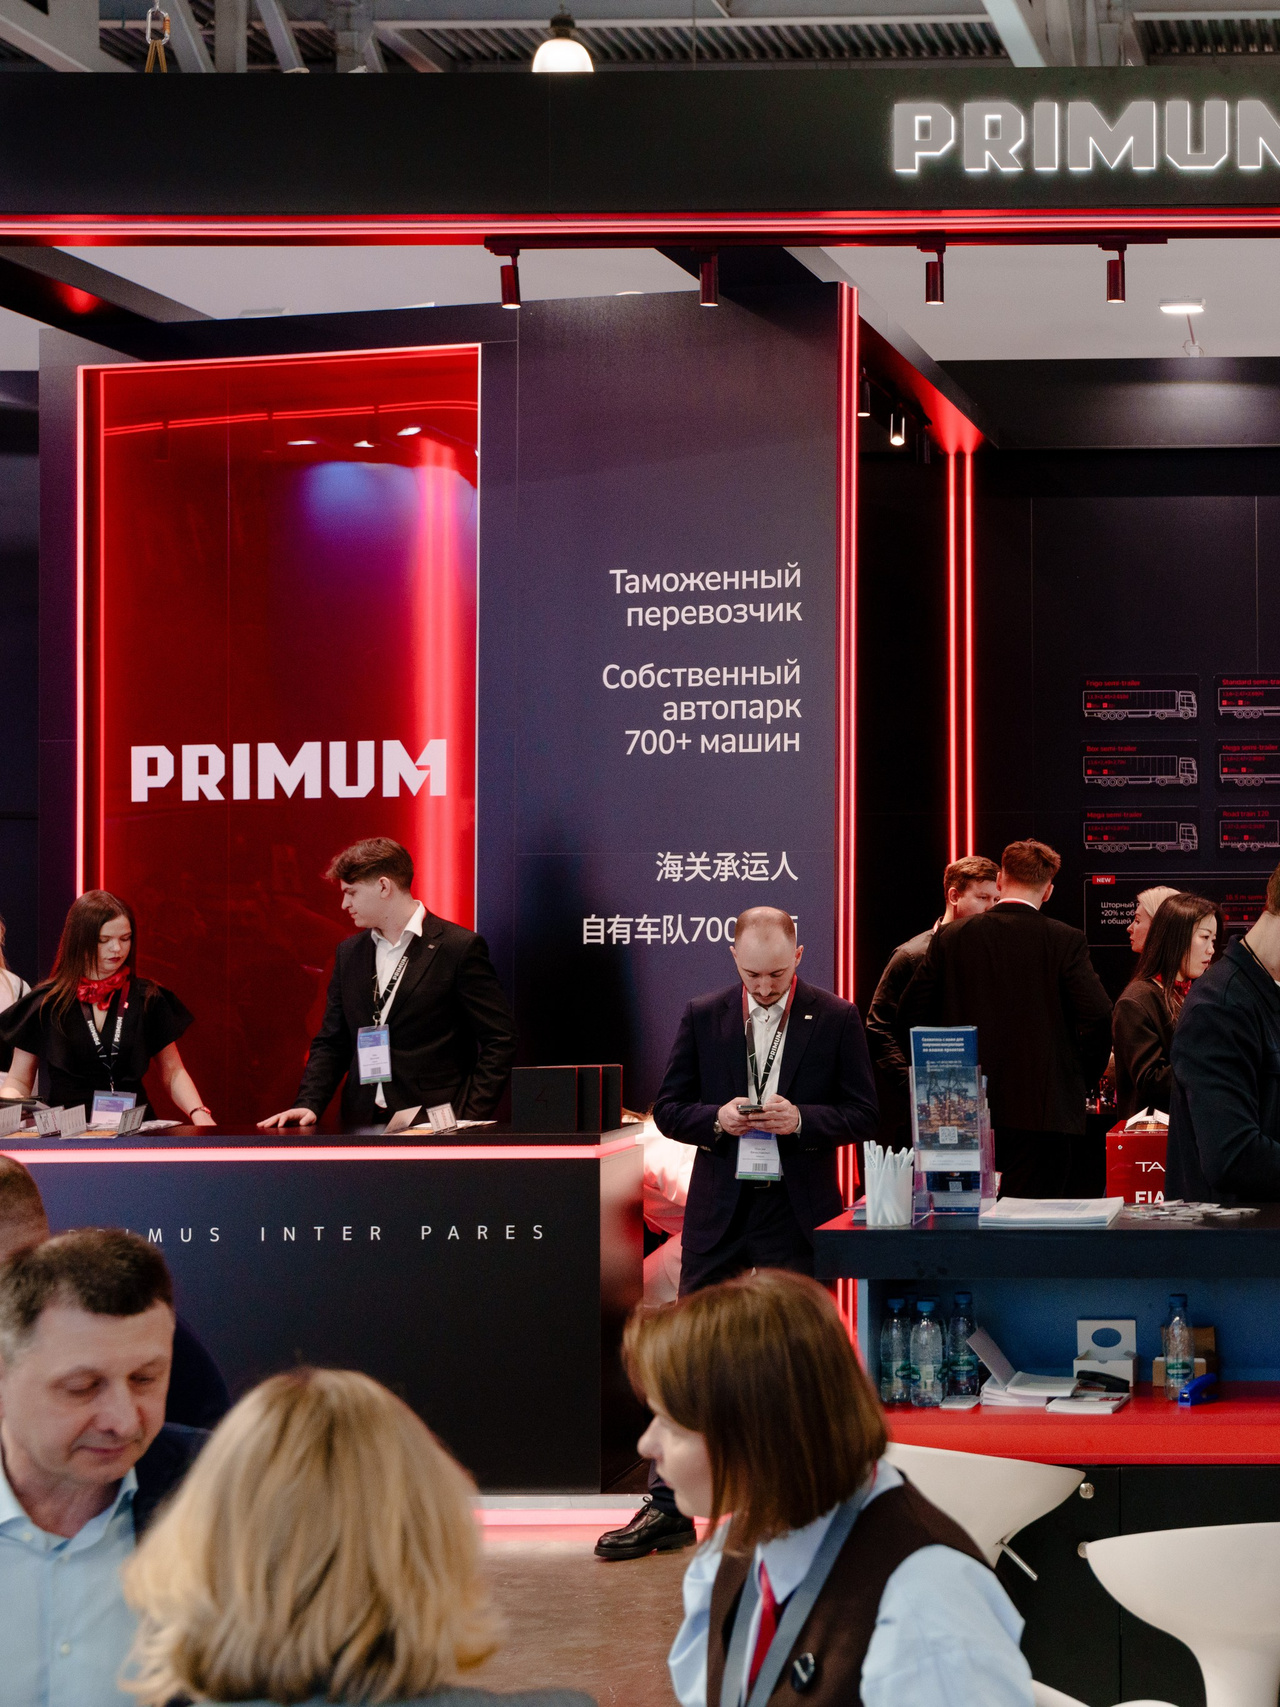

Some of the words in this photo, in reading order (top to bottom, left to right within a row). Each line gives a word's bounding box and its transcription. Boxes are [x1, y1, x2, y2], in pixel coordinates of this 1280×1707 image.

[609, 561, 801, 595] Таможенный
[626, 601, 803, 632] перевозчик
[602, 657, 801, 690] Собственный
[662, 698, 803, 725] автопарк
[625, 729, 692, 756] 700+
[700, 732, 800, 754] машин
[131, 738, 447, 803] PRIMUM
[656, 851, 798, 882] 海关承运人
[1101, 902, 1134, 910] Шторный
[583, 914, 798, 945] 自有车队700
[1107, 917, 1131, 925] общей
[392, 956, 408, 981] PRIMUM
[114, 1016, 123, 1042] PRIMUM
[769, 1031, 782, 1061] PRIMUM
[260, 1226, 381, 1241] INTER
[421, 1225, 543, 1240] PARES
